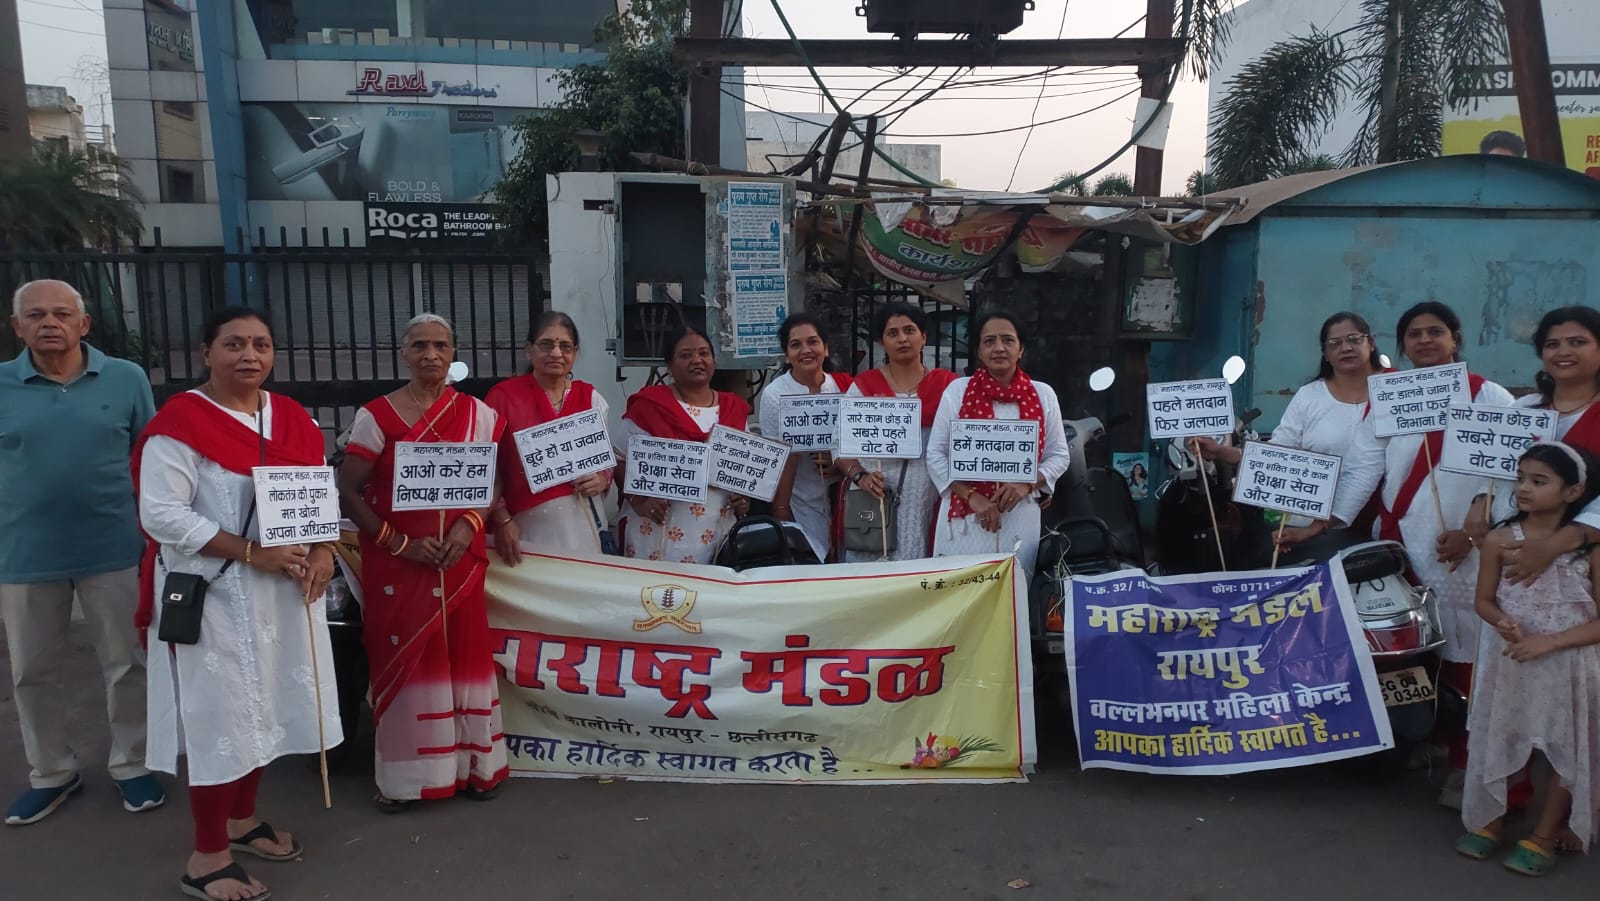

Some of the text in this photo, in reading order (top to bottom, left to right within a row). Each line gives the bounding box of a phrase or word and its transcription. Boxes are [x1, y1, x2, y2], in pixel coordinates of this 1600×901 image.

[1551, 70, 1600, 89] OMM
[388, 181, 442, 191] BOLD &
[367, 192, 442, 203] FLAWLESS
[368, 208, 439, 228] Roca
[443, 213, 461, 221] THE
[443, 222, 494, 231] BATHROOM
[1376, 391, 1396, 402] वोट
[1396, 385, 1425, 401] डालने
[1425, 383, 1451, 396] जाना
[1152, 395, 1228, 413] पहले मतदान
[1390, 402, 1424, 416] अपना
[783, 410, 831, 428] आओ करें
[847, 412, 864, 425] सारे
[865, 413, 885, 425] काम
[903, 412, 913, 425] दो
[1154, 415, 1230, 432] फिर जलपान
[1396, 415, 1436, 431] निभाना
[1451, 406, 1551, 431] सारे काम छोड़ दो
[559, 440, 573, 453] या
[573, 430, 606, 448] जवान
[852, 426, 908, 440] सबसे पहले
[1456, 428, 1497, 447] सबसे
[861, 440, 899, 455] वोट दो
[953, 435, 1036, 453] हमें मतदान का
[712, 442, 728, 454] वोट
[728, 447, 751, 461] डालने
[751, 454, 770, 467] जाना
[1469, 450, 1518, 473] वोट दो
[400, 460, 488, 479] आओ करें हम
[532, 468, 554, 485] सभी
[575, 451, 612, 471] मतदान
[638, 461, 697, 481] शिक्षा सेवा
[717, 458, 745, 473] अपना
[954, 457, 1034, 475] फर्ज निभाना है
[1248, 459, 1265, 471] युवा
[1265, 463, 1288, 475] शक्ति
[1288, 466, 1302, 477] का
[631, 475, 701, 498] और मतदान
[716, 470, 748, 490] निभाना
[1253, 470, 1321, 496] शिक्षा सेवा
[268, 486, 296, 502] लोकतंत्र
[309, 488, 328, 504] पुकार
[396, 484, 488, 503] निष्पक्ष मतदान
[1243, 486, 1325, 514] और मतदान
[280, 504, 320, 519] मत खोना
[265, 520, 338, 540] अपना अधिकार
[1086, 603, 1219, 637] महाराष्ट्र
[741, 634, 955, 707] मंडळ
[1157, 644, 1266, 690] रायपुर
[1089, 699, 1209, 724] वल्लभनगर
[1211, 691, 1291, 720] महिला
[1294, 681, 1352, 707] केन्द्र
[1394, 685, 1431, 703] 0340
[648, 725, 706, 744] रायपुर
[1094, 728, 1166, 758] आपका
[1171, 724, 1234, 756] हार्दिक
[1236, 722, 1306, 752] स्वागत
[504, 734, 562, 762] पका
[567, 740, 651, 768] हार्दिक
[656, 751, 741, 773] स्वागत
[748, 751, 816, 776] करता
